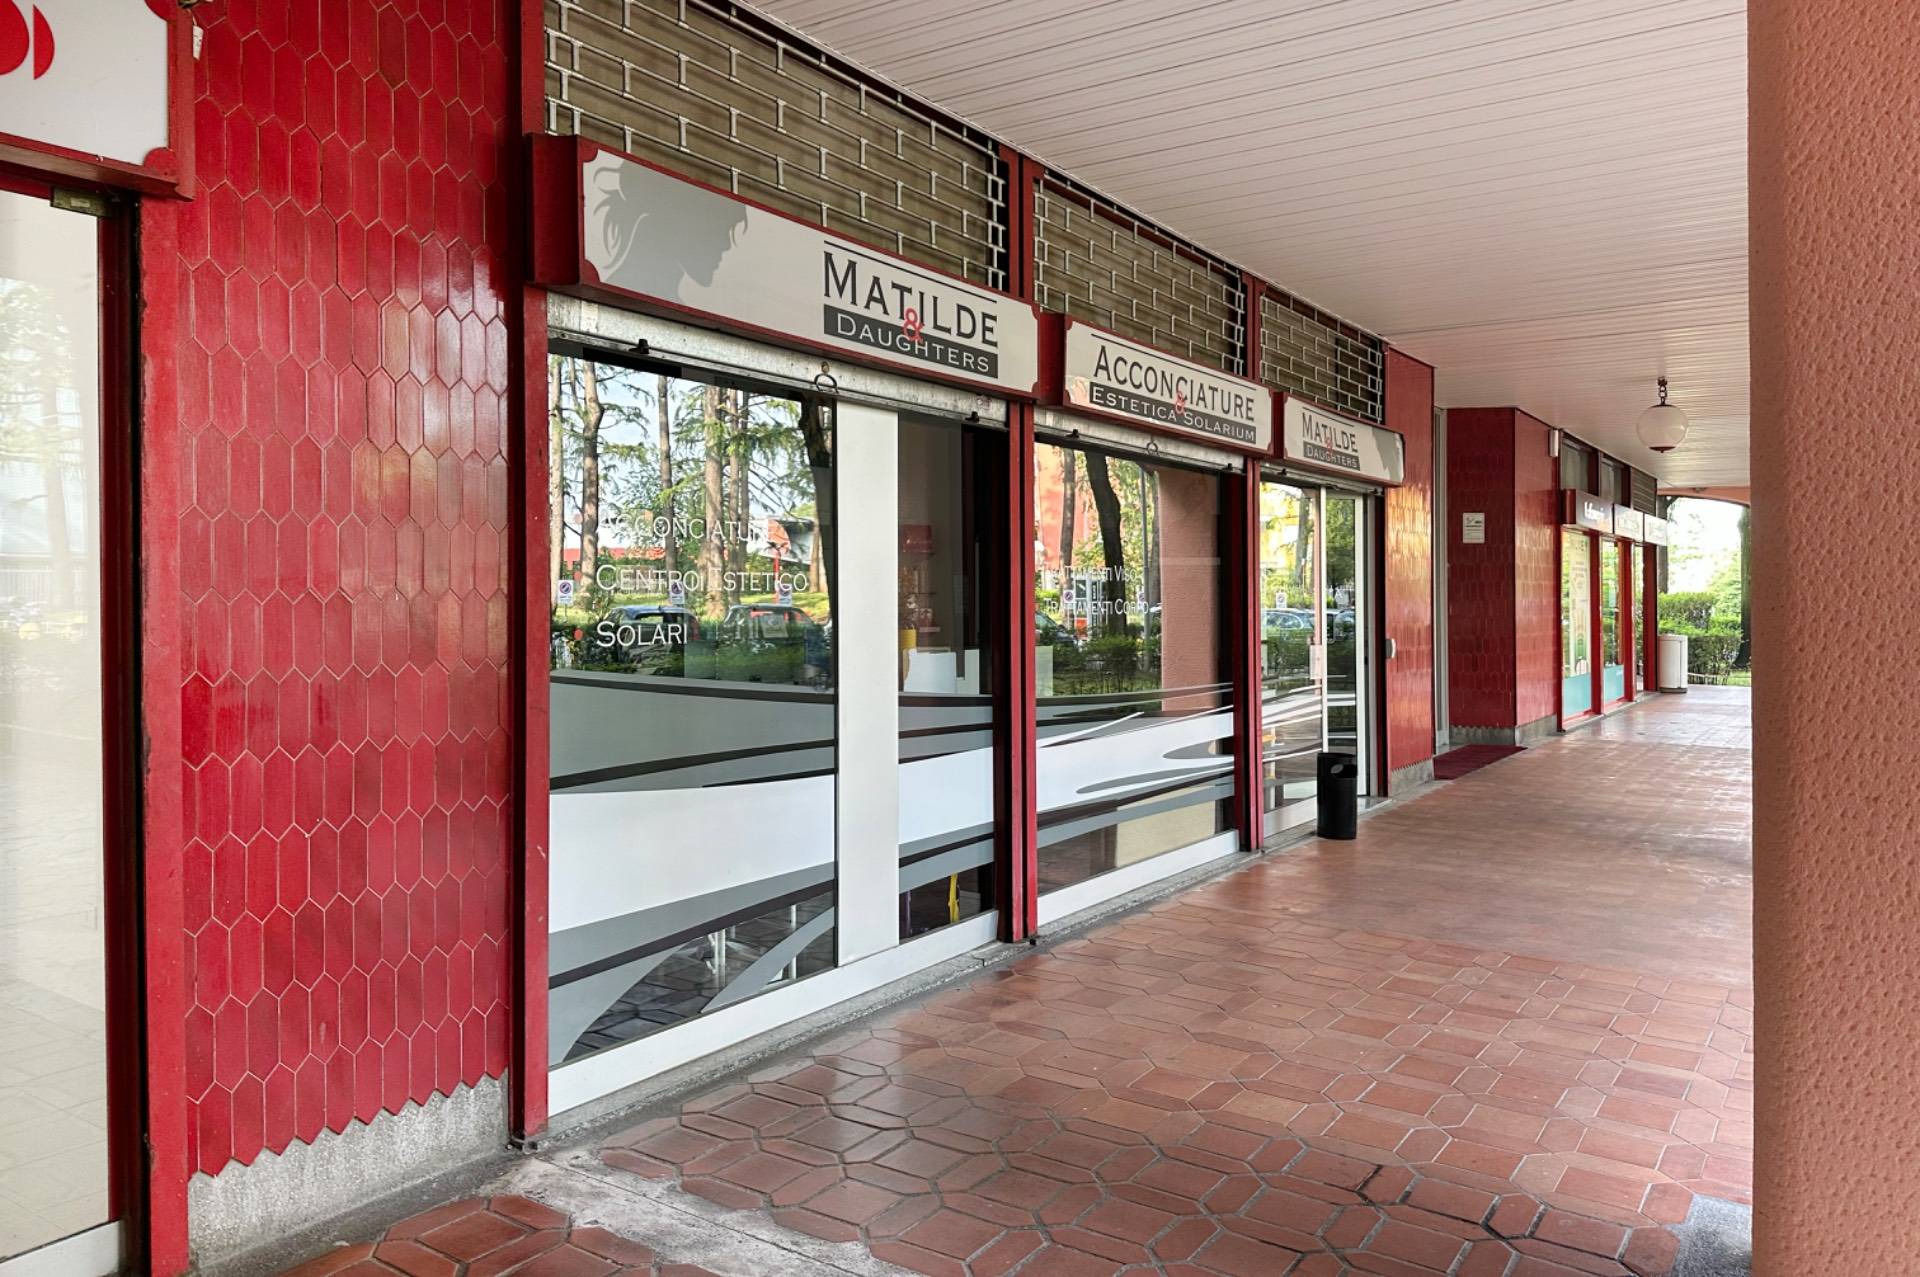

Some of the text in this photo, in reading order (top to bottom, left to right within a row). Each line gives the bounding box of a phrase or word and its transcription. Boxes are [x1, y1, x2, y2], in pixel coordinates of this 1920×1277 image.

[824, 251, 998, 347] MATILDE
[837, 312, 990, 373] DAUGHTERS
[1093, 345, 1255, 422] ACCONCIATURE
[1092, 386, 1178, 422] ESTETICA
[1183, 412, 1255, 441] SOLARIUM
[1302, 412, 1358, 453] MATILDE
[1306, 444, 1358, 468] DAUGHTERS
[595, 511, 776, 543] ACCONCIATU
[595, 564, 809, 592] CENTRO ESTETICO
[596, 620, 688, 647] SOLARI
